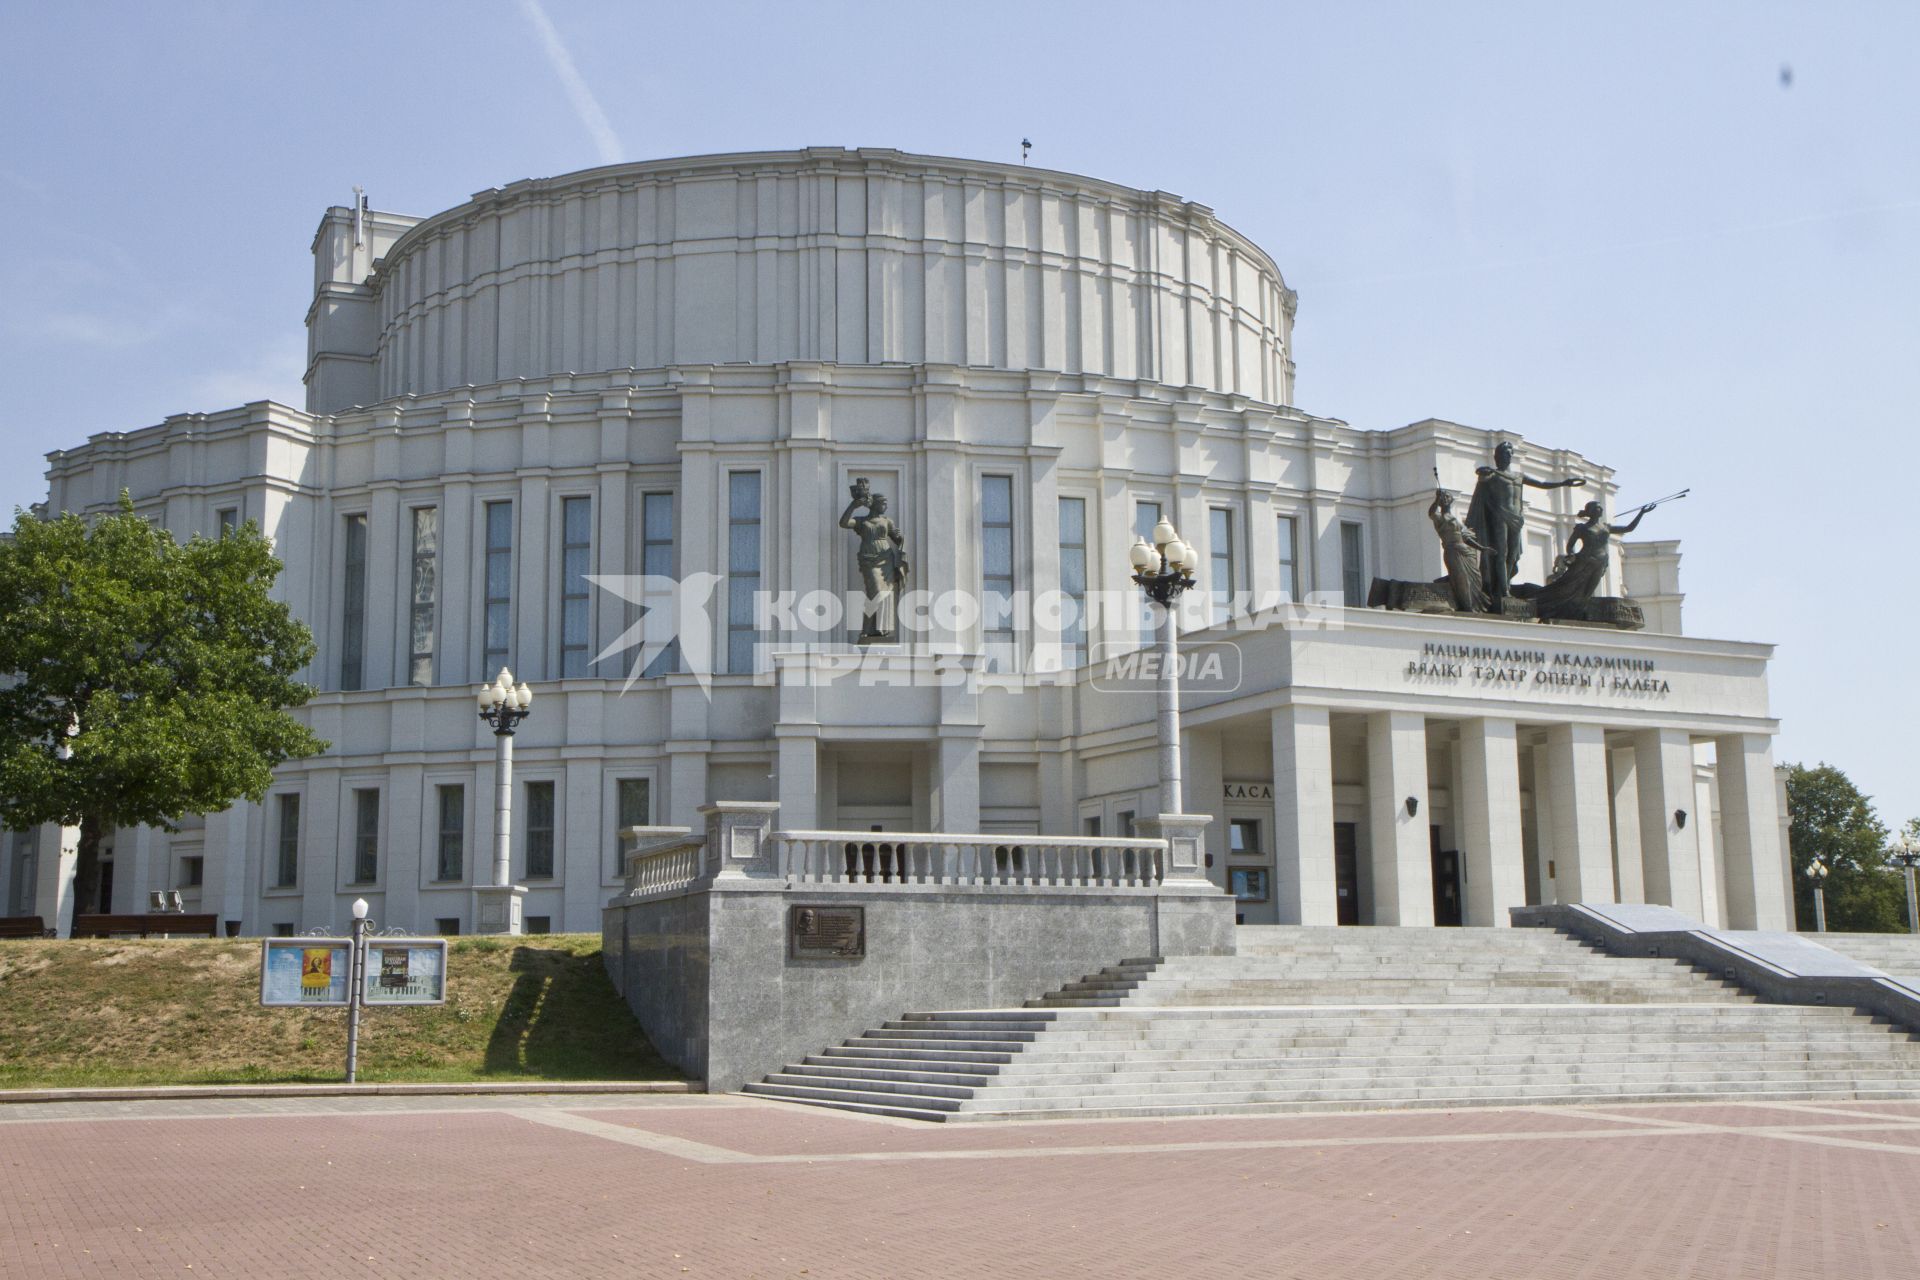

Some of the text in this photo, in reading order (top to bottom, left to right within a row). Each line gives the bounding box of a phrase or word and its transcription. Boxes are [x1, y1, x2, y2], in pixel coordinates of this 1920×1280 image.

[1424, 643, 1654, 672] НАЦЫЯНАЛЬНЫ АКАДЭМІЧНЫ
[1408, 661, 1462, 678] ВЯЛІКІ
[1474, 666, 1527, 682] ТЭАТР
[1535, 671, 1592, 688] ОПЕРЫ
[1614, 676, 1670, 693] БАЛЕТА
[1224, 784, 1272, 798] КАСА
